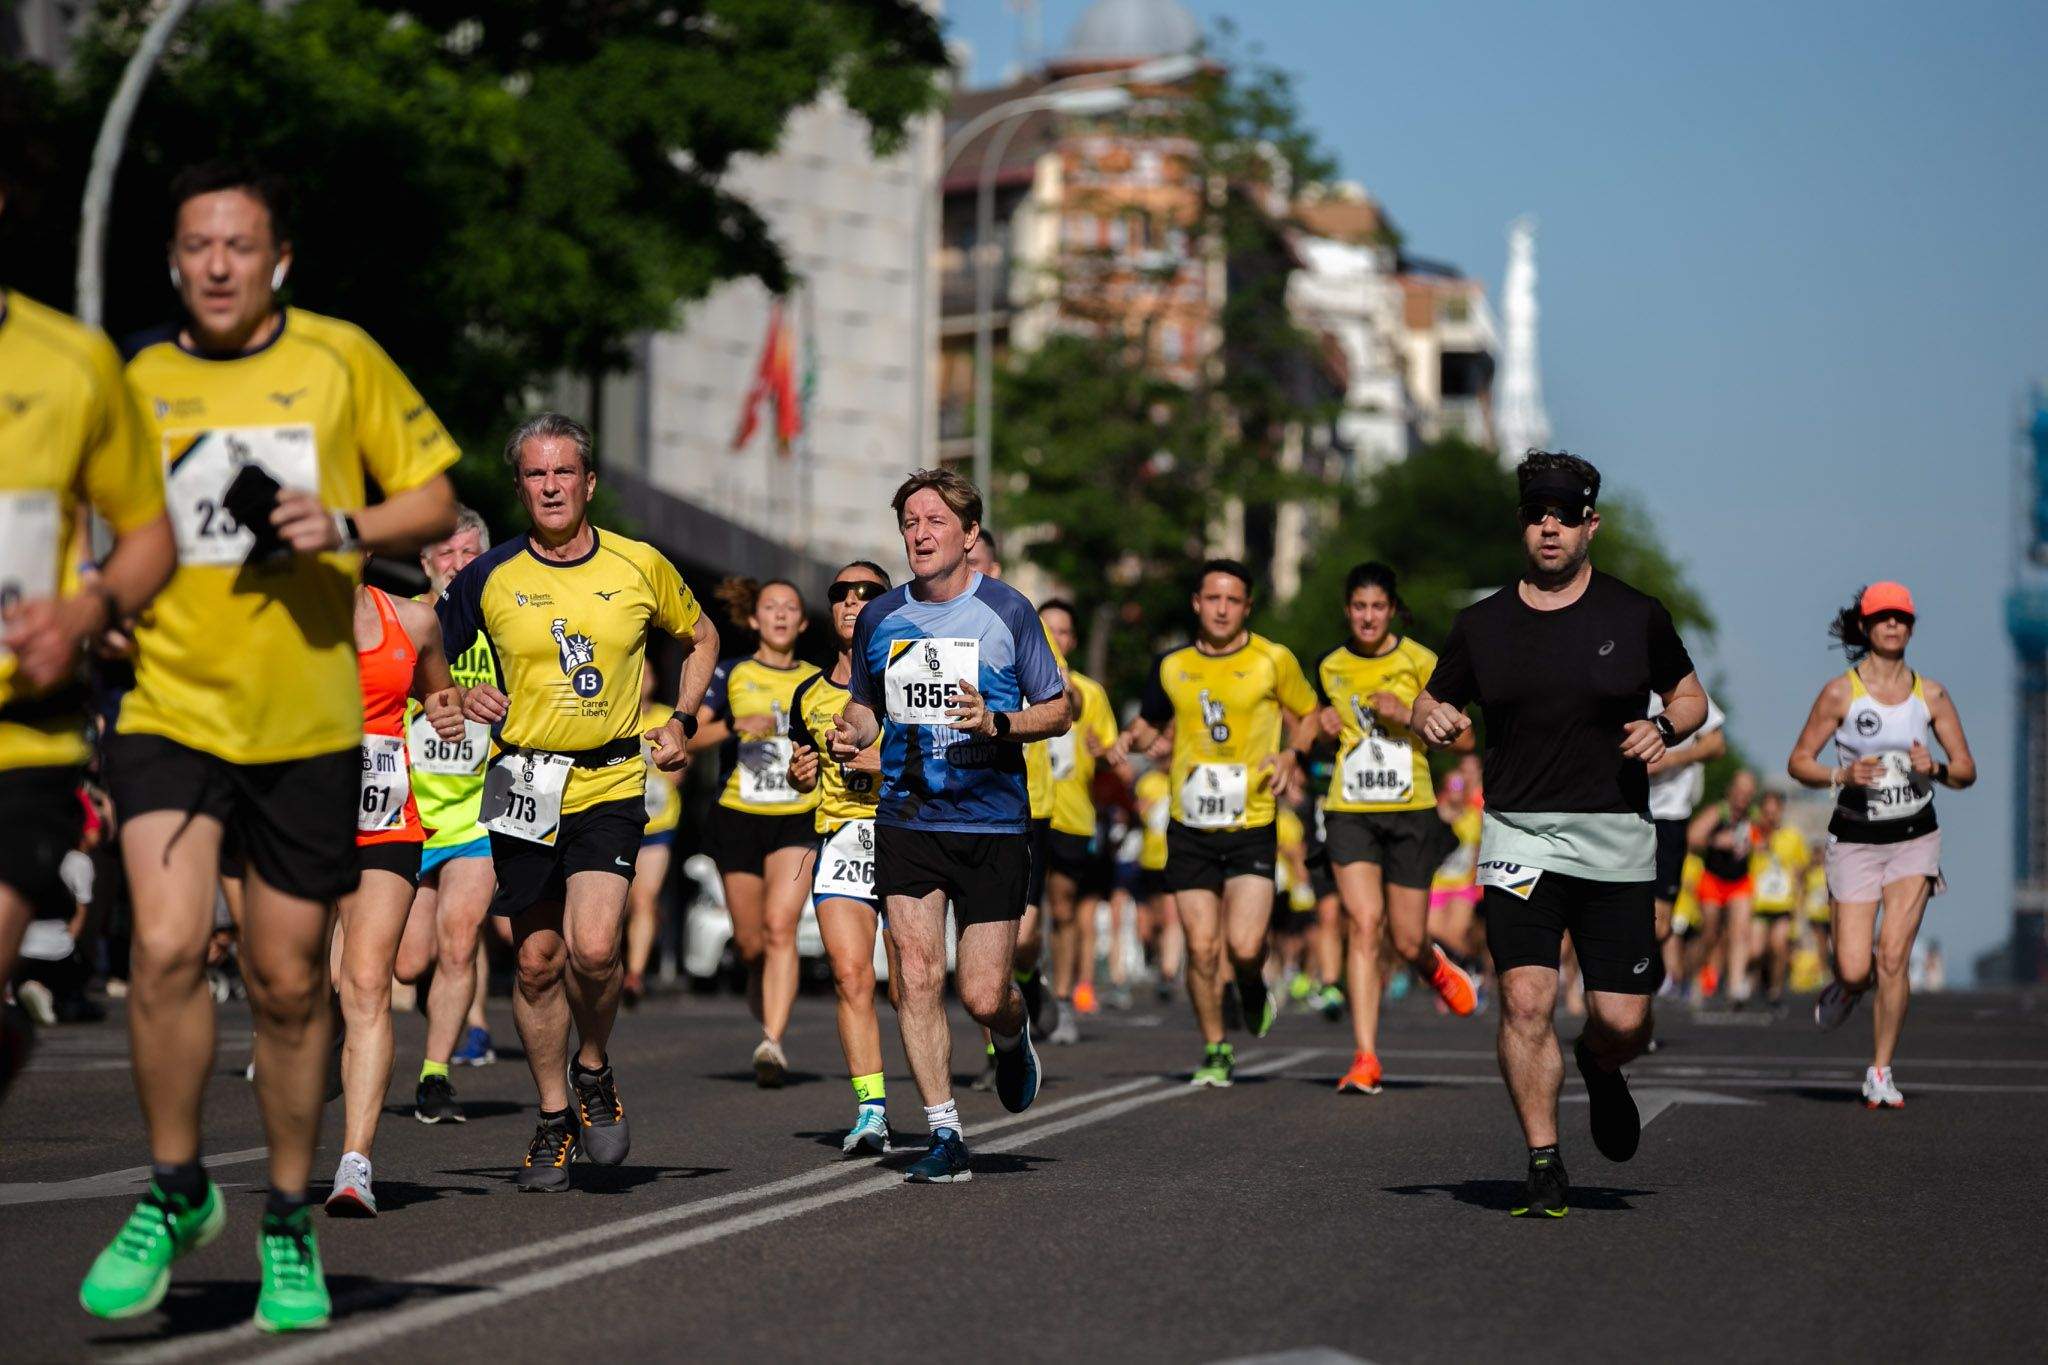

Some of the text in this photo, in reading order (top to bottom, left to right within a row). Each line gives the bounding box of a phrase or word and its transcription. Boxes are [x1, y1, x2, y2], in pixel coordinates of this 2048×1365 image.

[578, 673, 597, 690] 13
[582, 699, 609, 708] Carrera
[903, 683, 959, 708] 1355
[582, 708, 609, 718] Liberty
[424, 738, 473, 760] 3675
[1357, 769, 1397, 789] 1848
[362, 785, 391, 813] 61
[505, 790, 537, 824] 773
[1199, 796, 1226, 815] 791
